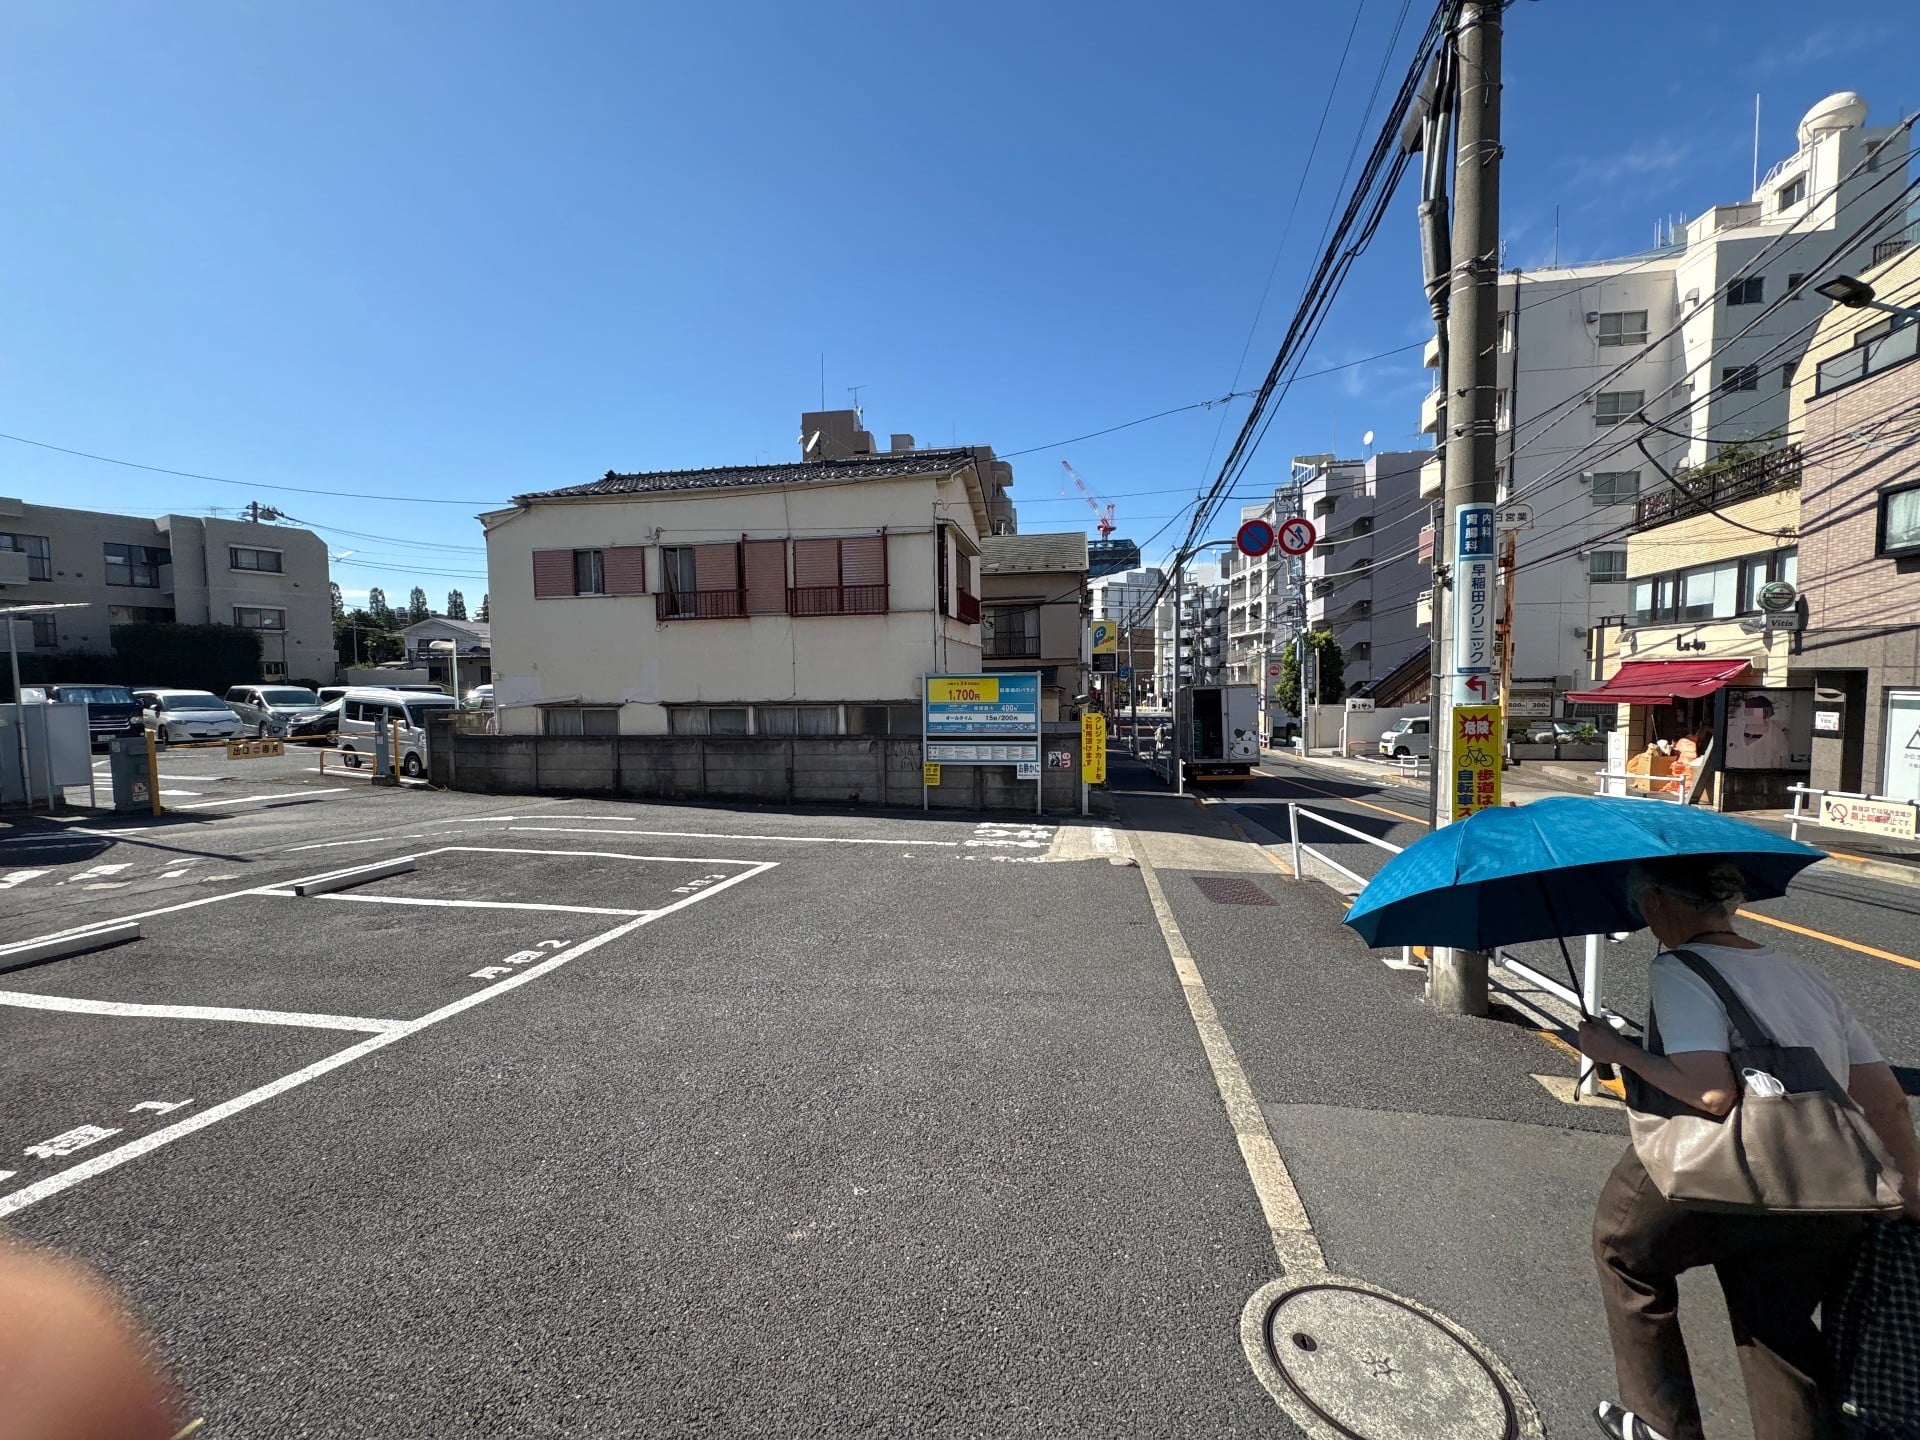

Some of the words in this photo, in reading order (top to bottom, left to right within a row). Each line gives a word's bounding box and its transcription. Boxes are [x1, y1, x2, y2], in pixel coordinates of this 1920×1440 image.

[1465, 513, 1479, 552] 胃腸科
[1481, 513, 1492, 538] 内科
[1470, 563, 1487, 664] 早稲田クリニック
[947, 688, 981, 702] 1,700円
[1464, 720, 1490, 735] 危険
[232, 745, 250, 756] 出口
[1477, 768, 1495, 809] 歩道は
